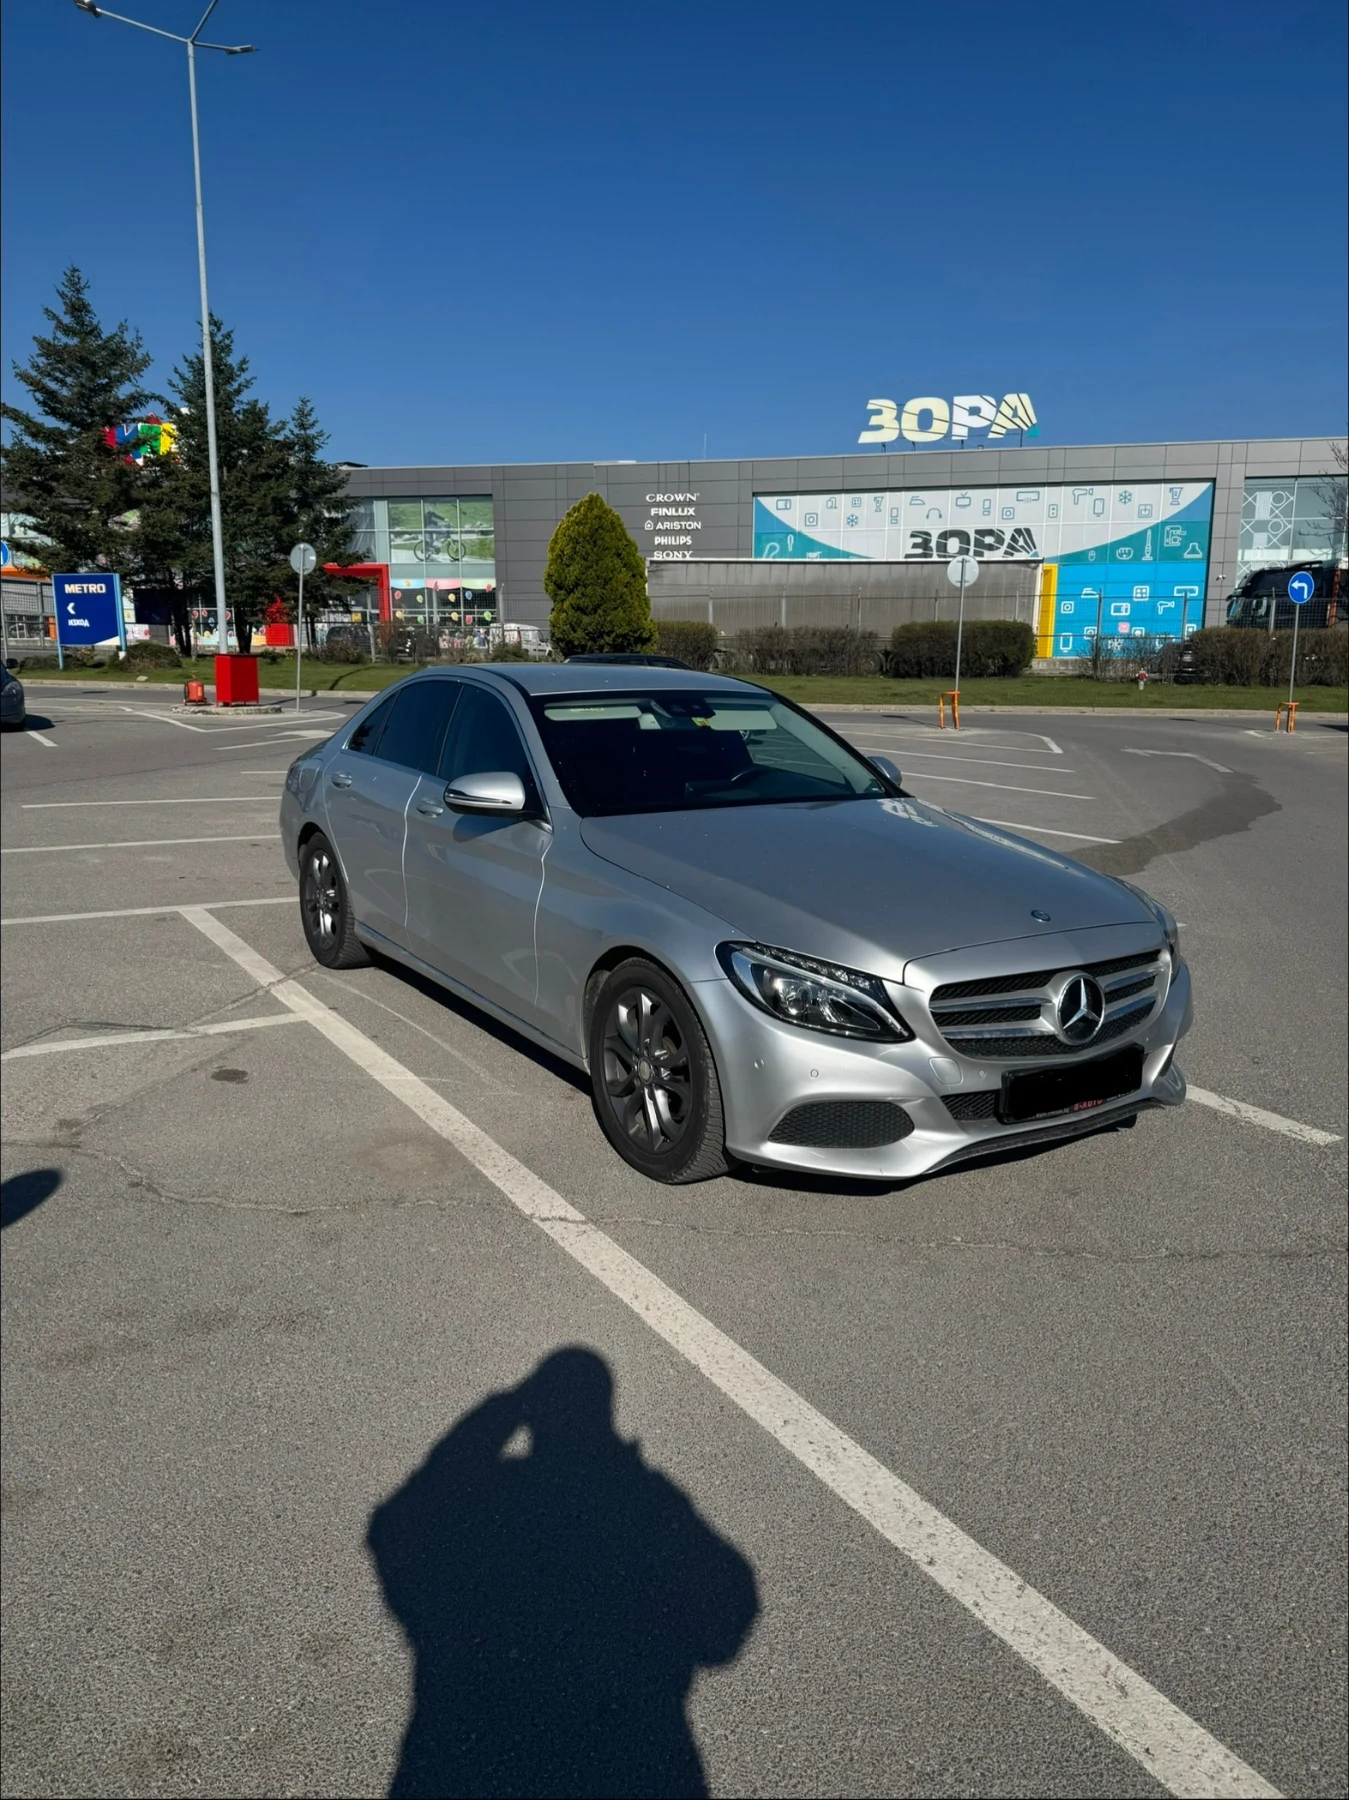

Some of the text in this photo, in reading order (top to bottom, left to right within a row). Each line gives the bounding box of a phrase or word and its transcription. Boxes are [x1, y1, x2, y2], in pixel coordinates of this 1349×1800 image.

[857, 393, 1038, 444] ЗОРА
[650, 507, 696, 516] FINLUX
[655, 521, 702, 530] ARISTON
[654, 535, 692, 546] PHILIPS
[903, 527, 1038, 559] ЗОРА
[653, 550, 693, 559] SONY
[64, 583, 106, 594] METRO
